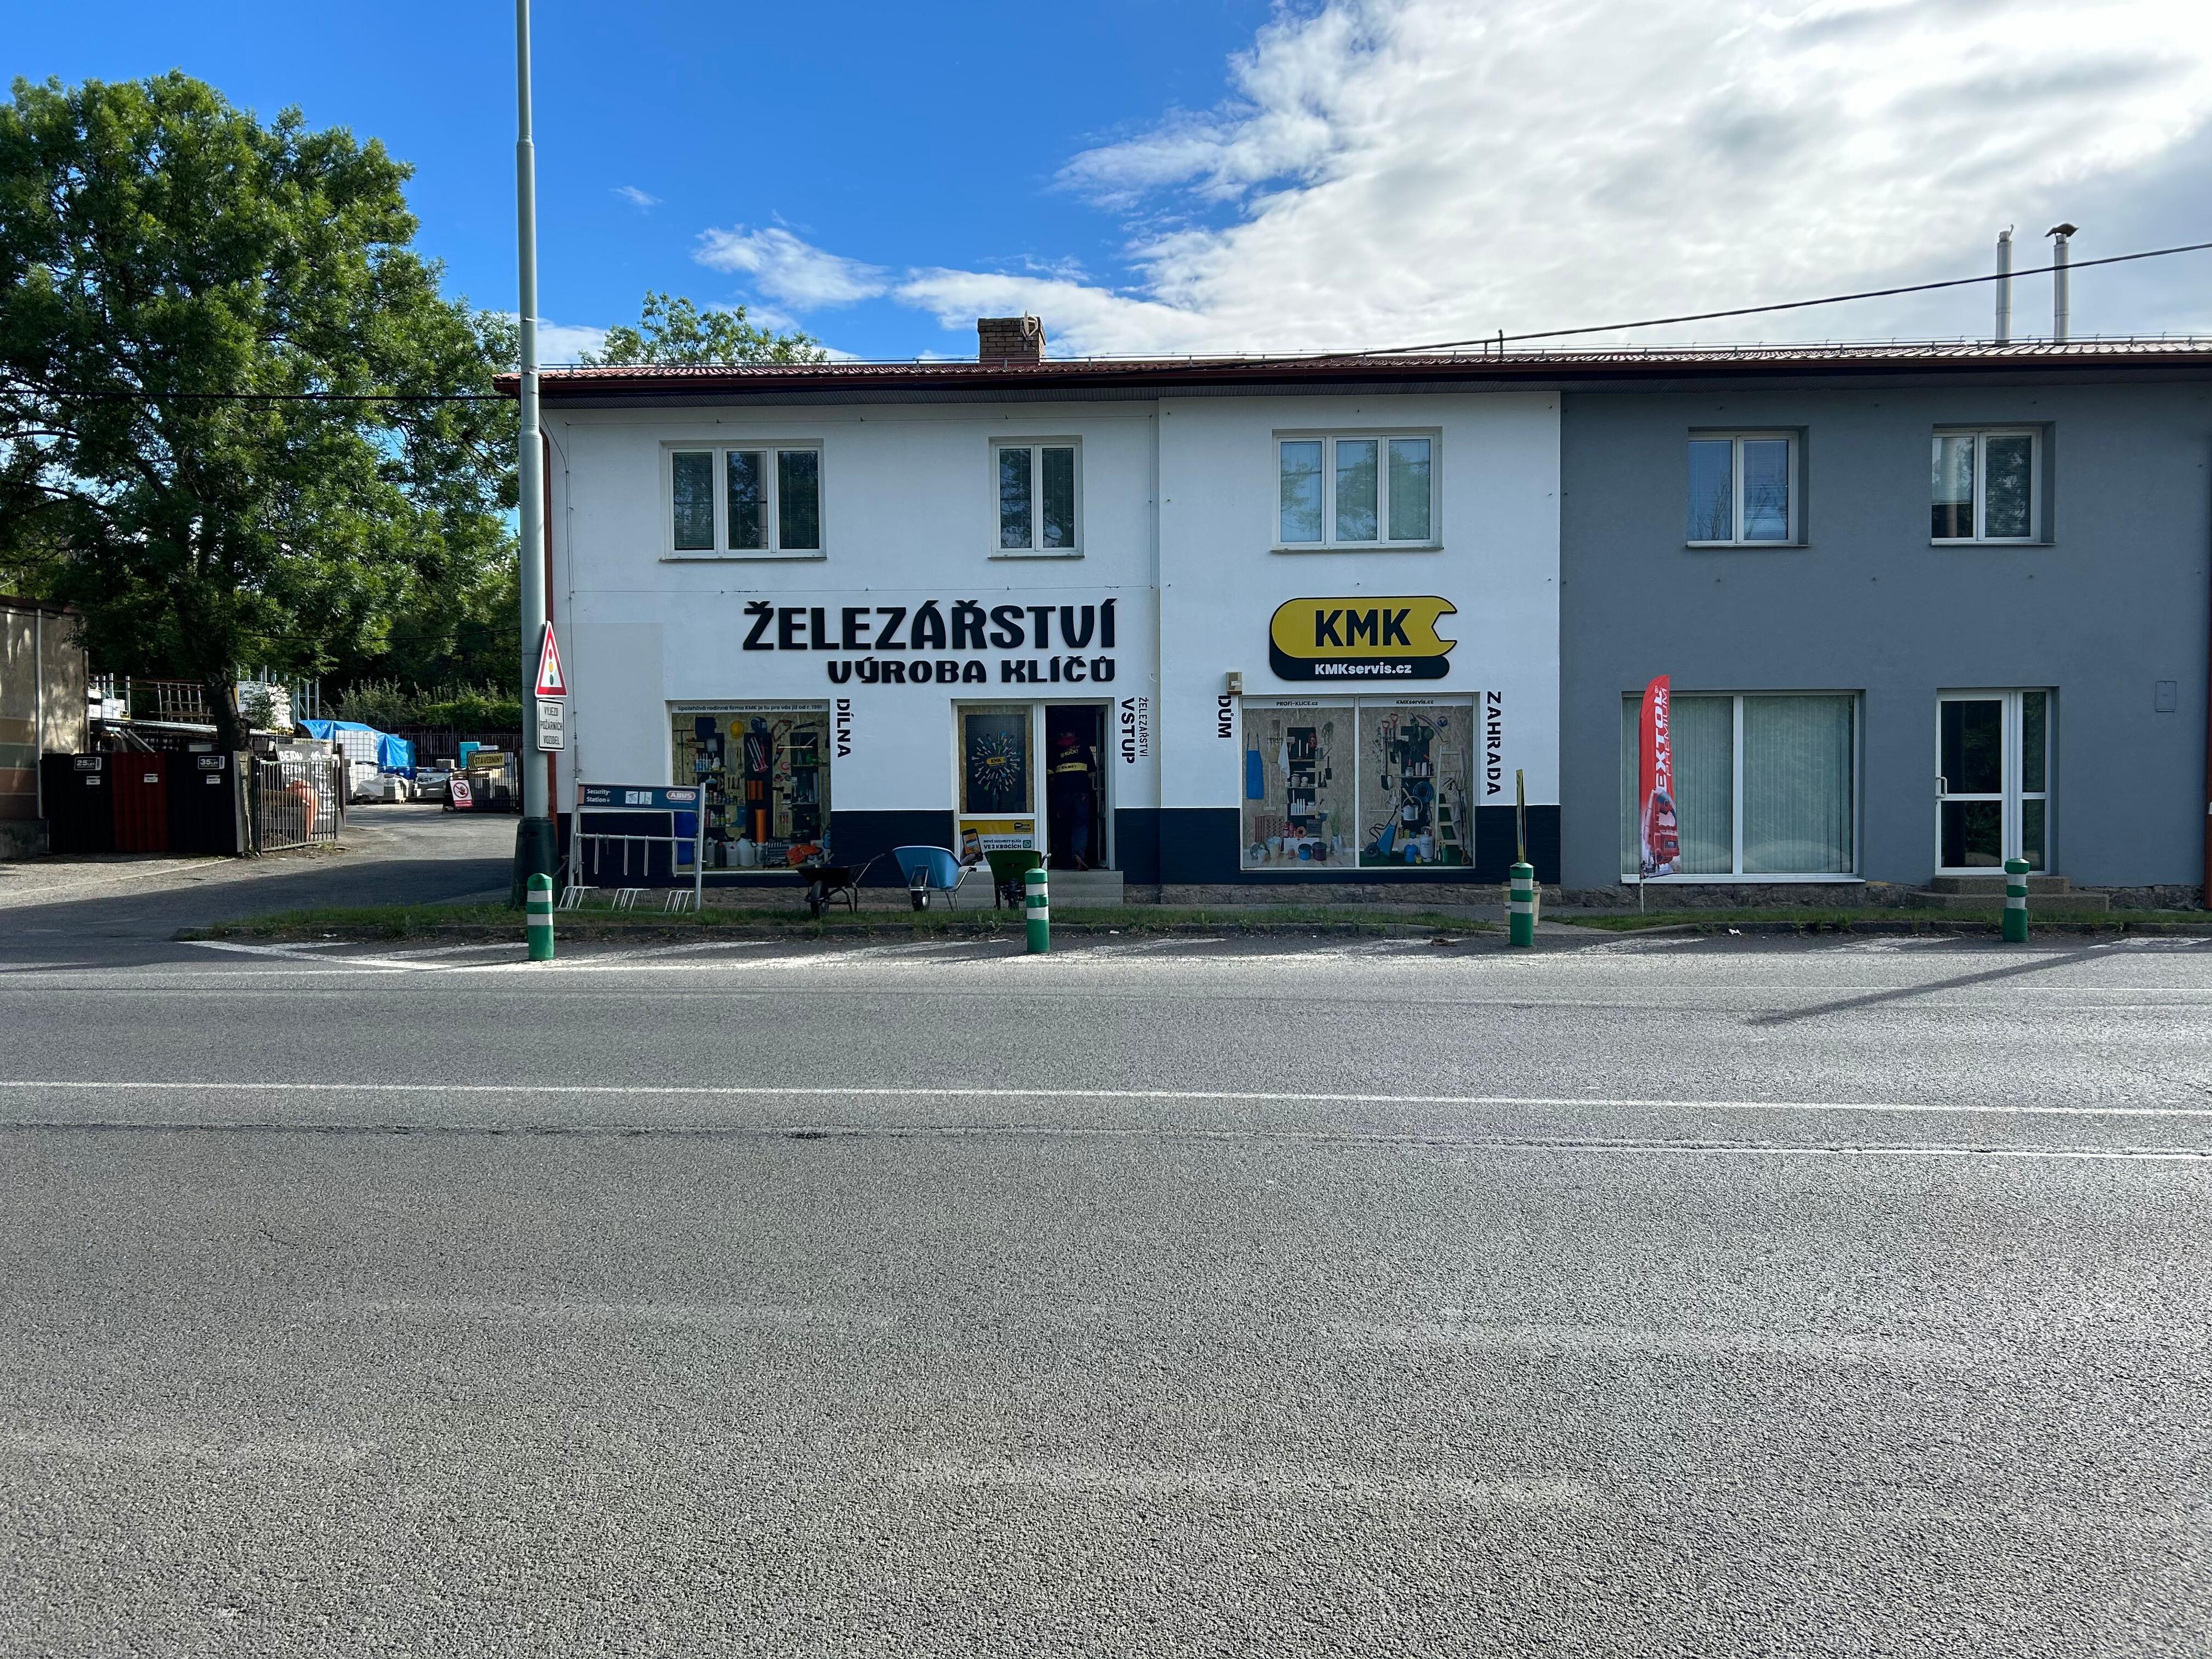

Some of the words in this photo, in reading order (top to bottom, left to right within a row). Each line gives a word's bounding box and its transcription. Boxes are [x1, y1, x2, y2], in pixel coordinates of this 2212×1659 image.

[743, 598, 1117, 650] ŽELEZÁŘSTVÍ
[1316, 609, 1411, 646] KMK
[828, 656, 987, 683] VÝROBA
[1001, 655, 1115, 683] KLÍČŮ
[1315, 662, 1412, 674] KMKservis.cz
[543, 735, 560, 745] VOZIDEL
[837, 698, 854, 758] DÍLNA
[1121, 697, 1135, 764] VSTUP
[1139, 697, 1149, 757] ŽELEZÁŘSTVÍ
[1218, 695, 1234, 738] DŮM
[1654, 689, 1667, 792] EXTOL
[1662, 688, 1671, 777] PREMIUM
[474, 755, 503, 765] STAVEBNINY
[1487, 691, 1501, 796] ZAHRADA
